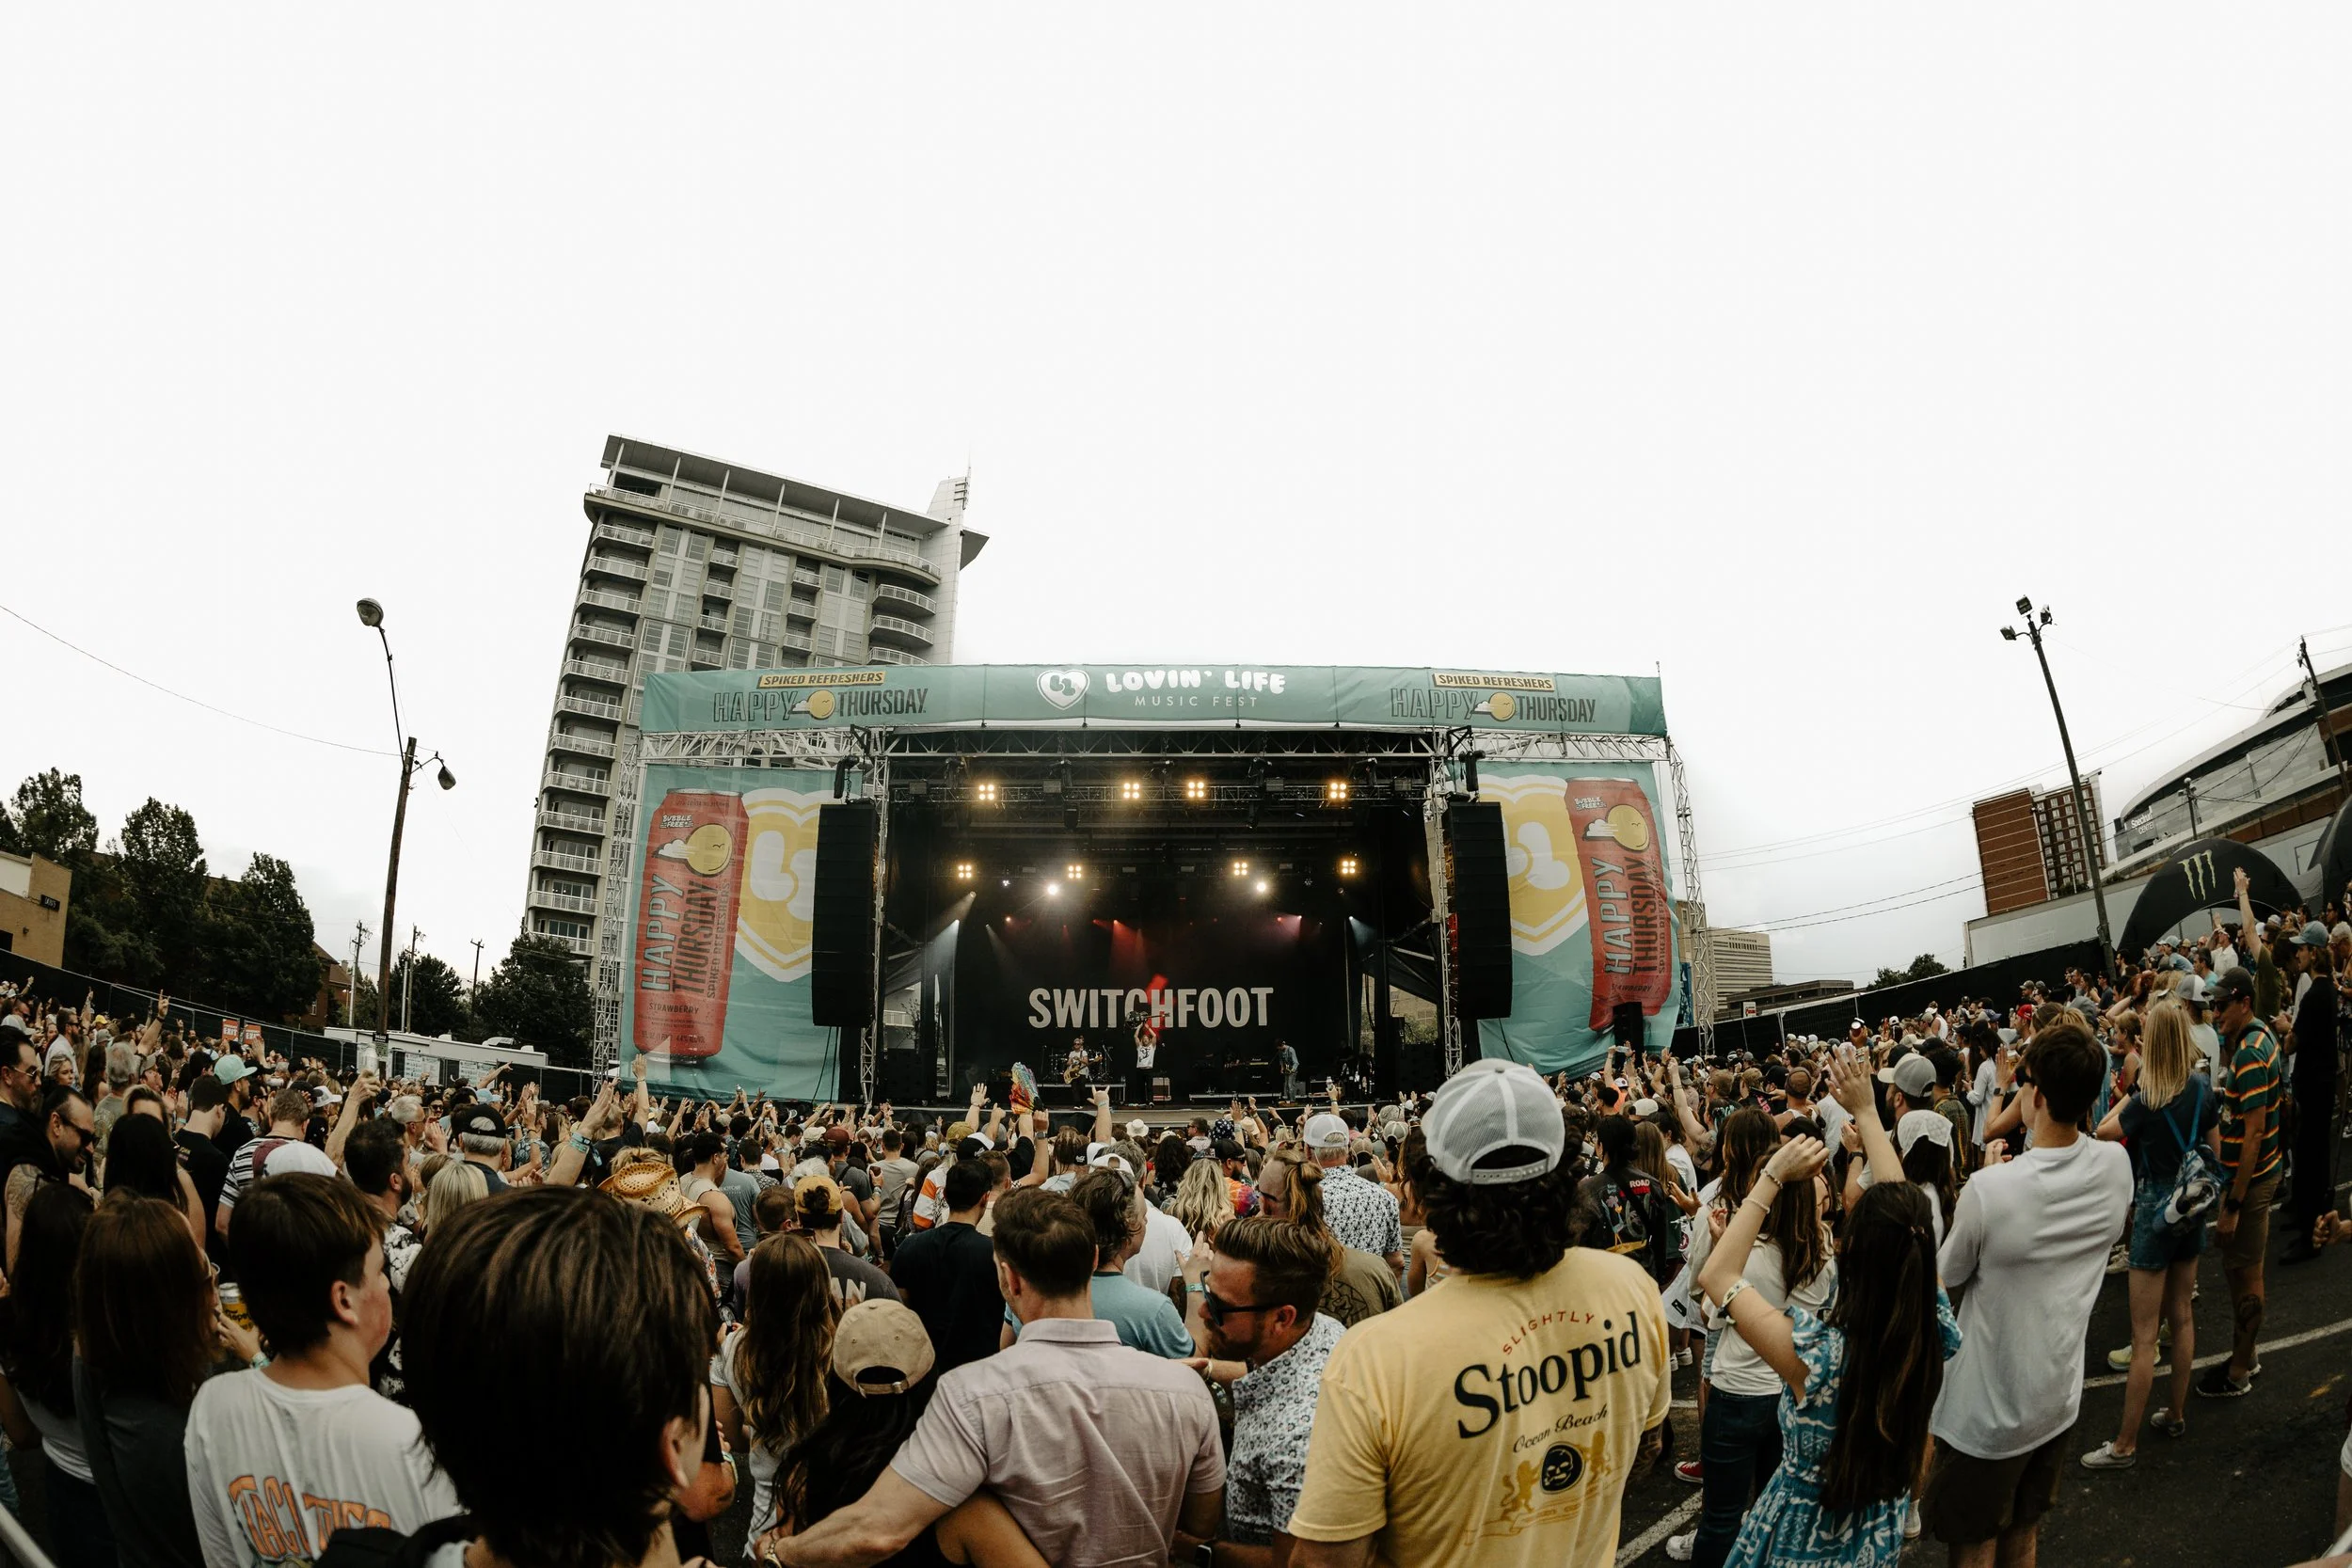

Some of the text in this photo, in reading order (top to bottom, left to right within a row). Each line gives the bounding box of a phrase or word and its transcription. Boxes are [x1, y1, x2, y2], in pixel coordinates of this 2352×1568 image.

[764, 673, 883, 686] SPIKED REFRESHERS
[1105, 669, 1286, 694] LOVIN' LIFE
[1438, 674, 1552, 689] SPIKED REFRESHERS
[713, 690, 798, 722] HAPPY
[1135, 696, 1258, 707] MUSIC FEST
[1391, 688, 1478, 720] HAPPY
[641, 874, 684, 992] HAPPY
[1591, 857, 1632, 974] HAPPY
[1625, 856, 1658, 975] THURSDAY
[673, 880, 718, 994] THURSDAY
[707, 883, 730, 999] SPIKED REFRESHERS
[649, 1002, 699, 1015] STRAWBERRY
[1028, 987, 1274, 1029] SWITCHFOOT
[1629, 1180, 1650, 1188] ROAD
[1502, 1311, 1595, 1355] SLIGHTLY
[1454, 1310, 1642, 1439] Stoopid
[1512, 1402, 1610, 1453] Ocean Beach
